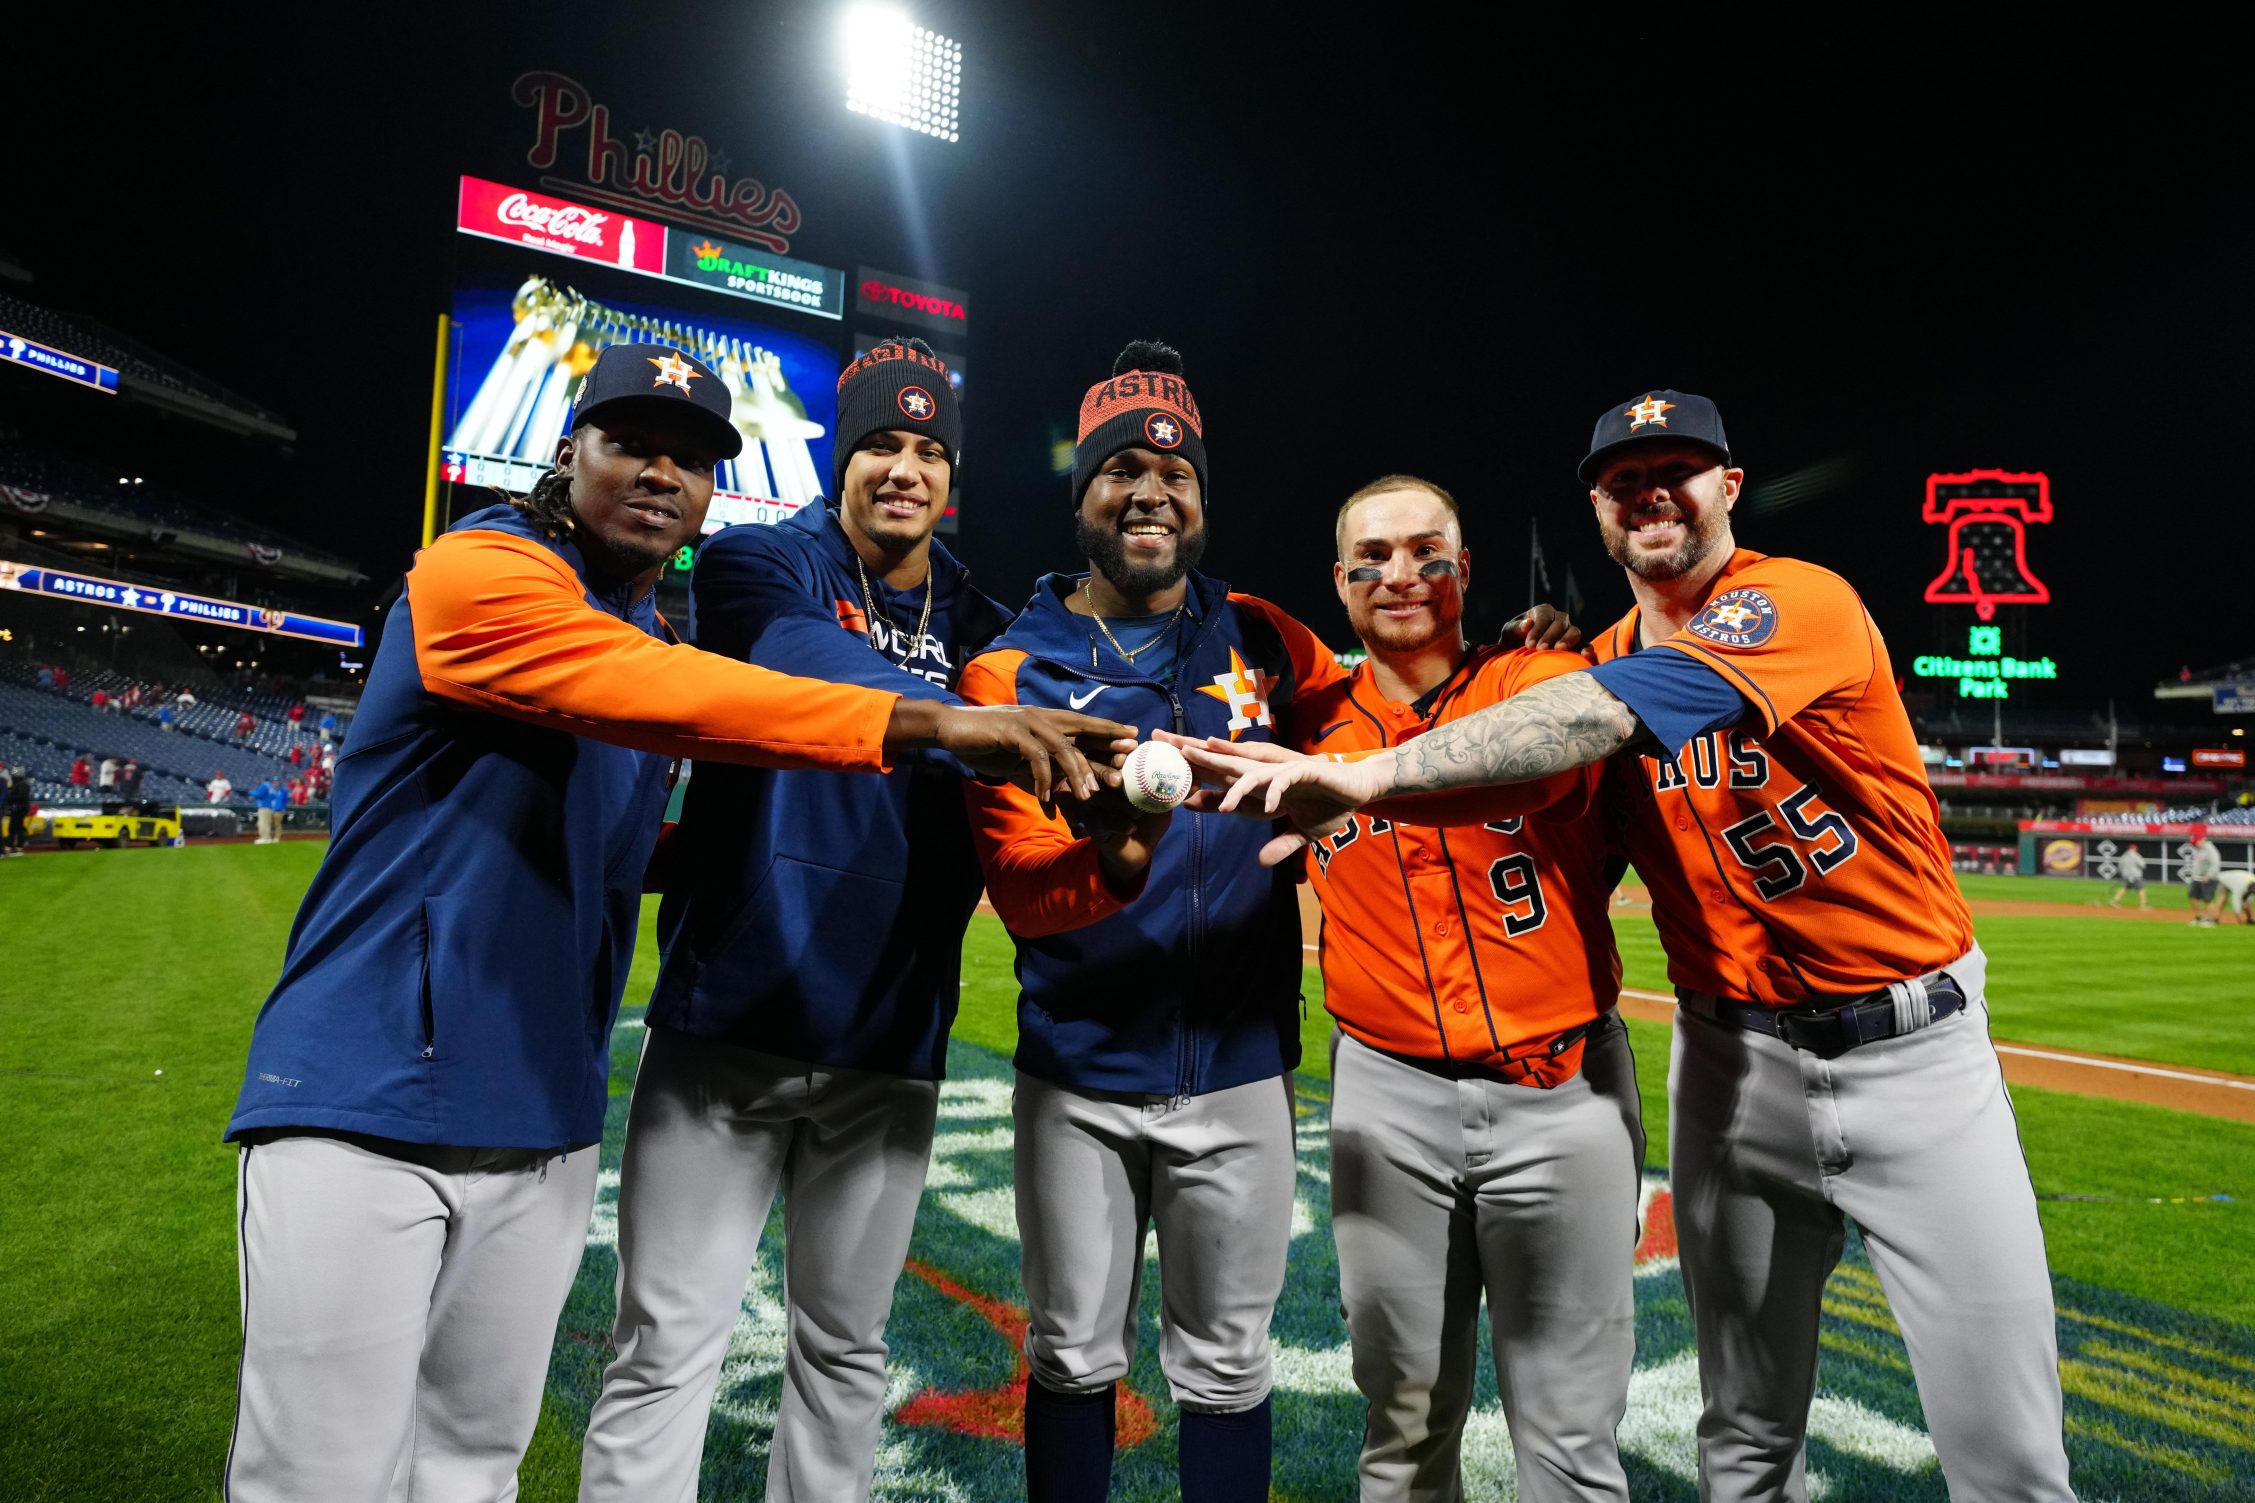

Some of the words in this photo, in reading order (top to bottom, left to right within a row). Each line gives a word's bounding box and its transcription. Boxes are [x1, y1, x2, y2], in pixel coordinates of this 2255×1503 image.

[511, 71, 801, 235] Phillies
[497, 193, 608, 246] Coca-Cola
[697, 255, 823, 295] DRAFTKINGS
[727, 275, 821, 307] SPORTSBOOK
[888, 288, 965, 320] TOYOTA
[28, 349, 86, 376] PHILLIES
[54, 578, 116, 599] ASTROS
[179, 600, 240, 621] PHILLIES
[1709, 590, 1773, 615] HOUSTON
[1692, 624, 1751, 644] ASTROS
[1913, 656, 1999, 678] Citizens
[2000, 657, 2057, 678] Bank
[1960, 677, 2008, 699] Park
[1720, 778, 1859, 902] 55
[1488, 852, 1548, 938] 9
